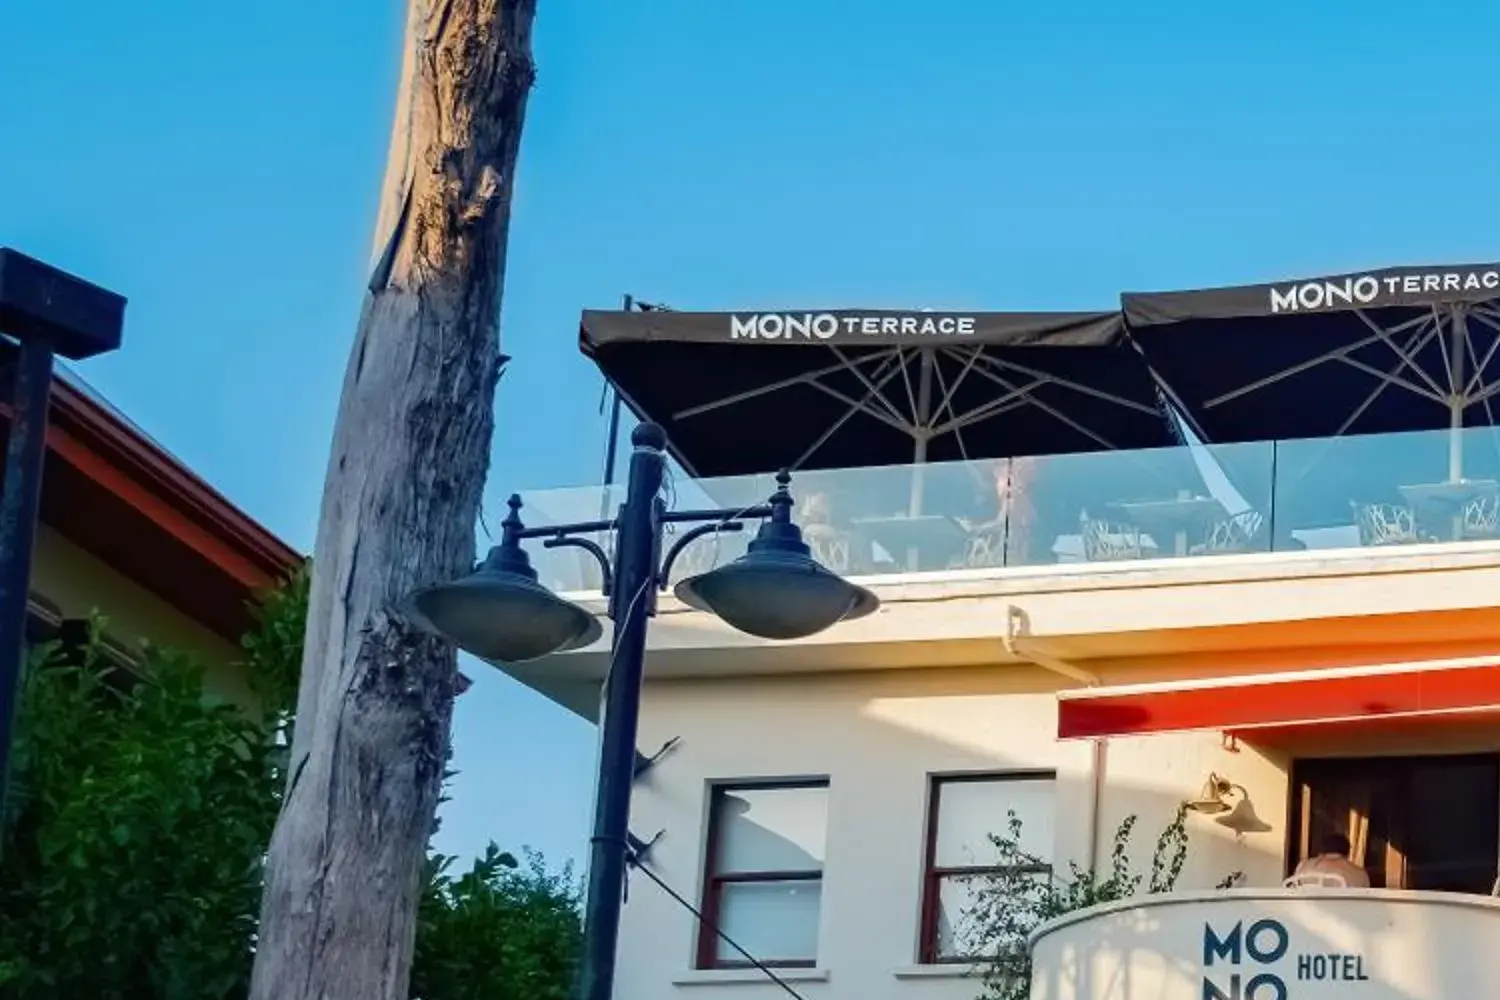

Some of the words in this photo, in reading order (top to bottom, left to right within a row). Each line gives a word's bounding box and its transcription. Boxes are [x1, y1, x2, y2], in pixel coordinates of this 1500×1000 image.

[1270, 275, 1379, 313] MONO
[730, 313, 839, 339] MONO
[842, 316, 976, 335] TERRACE
[1203, 919, 1289, 966] MO
[1297, 953, 1369, 981] HOTEL
